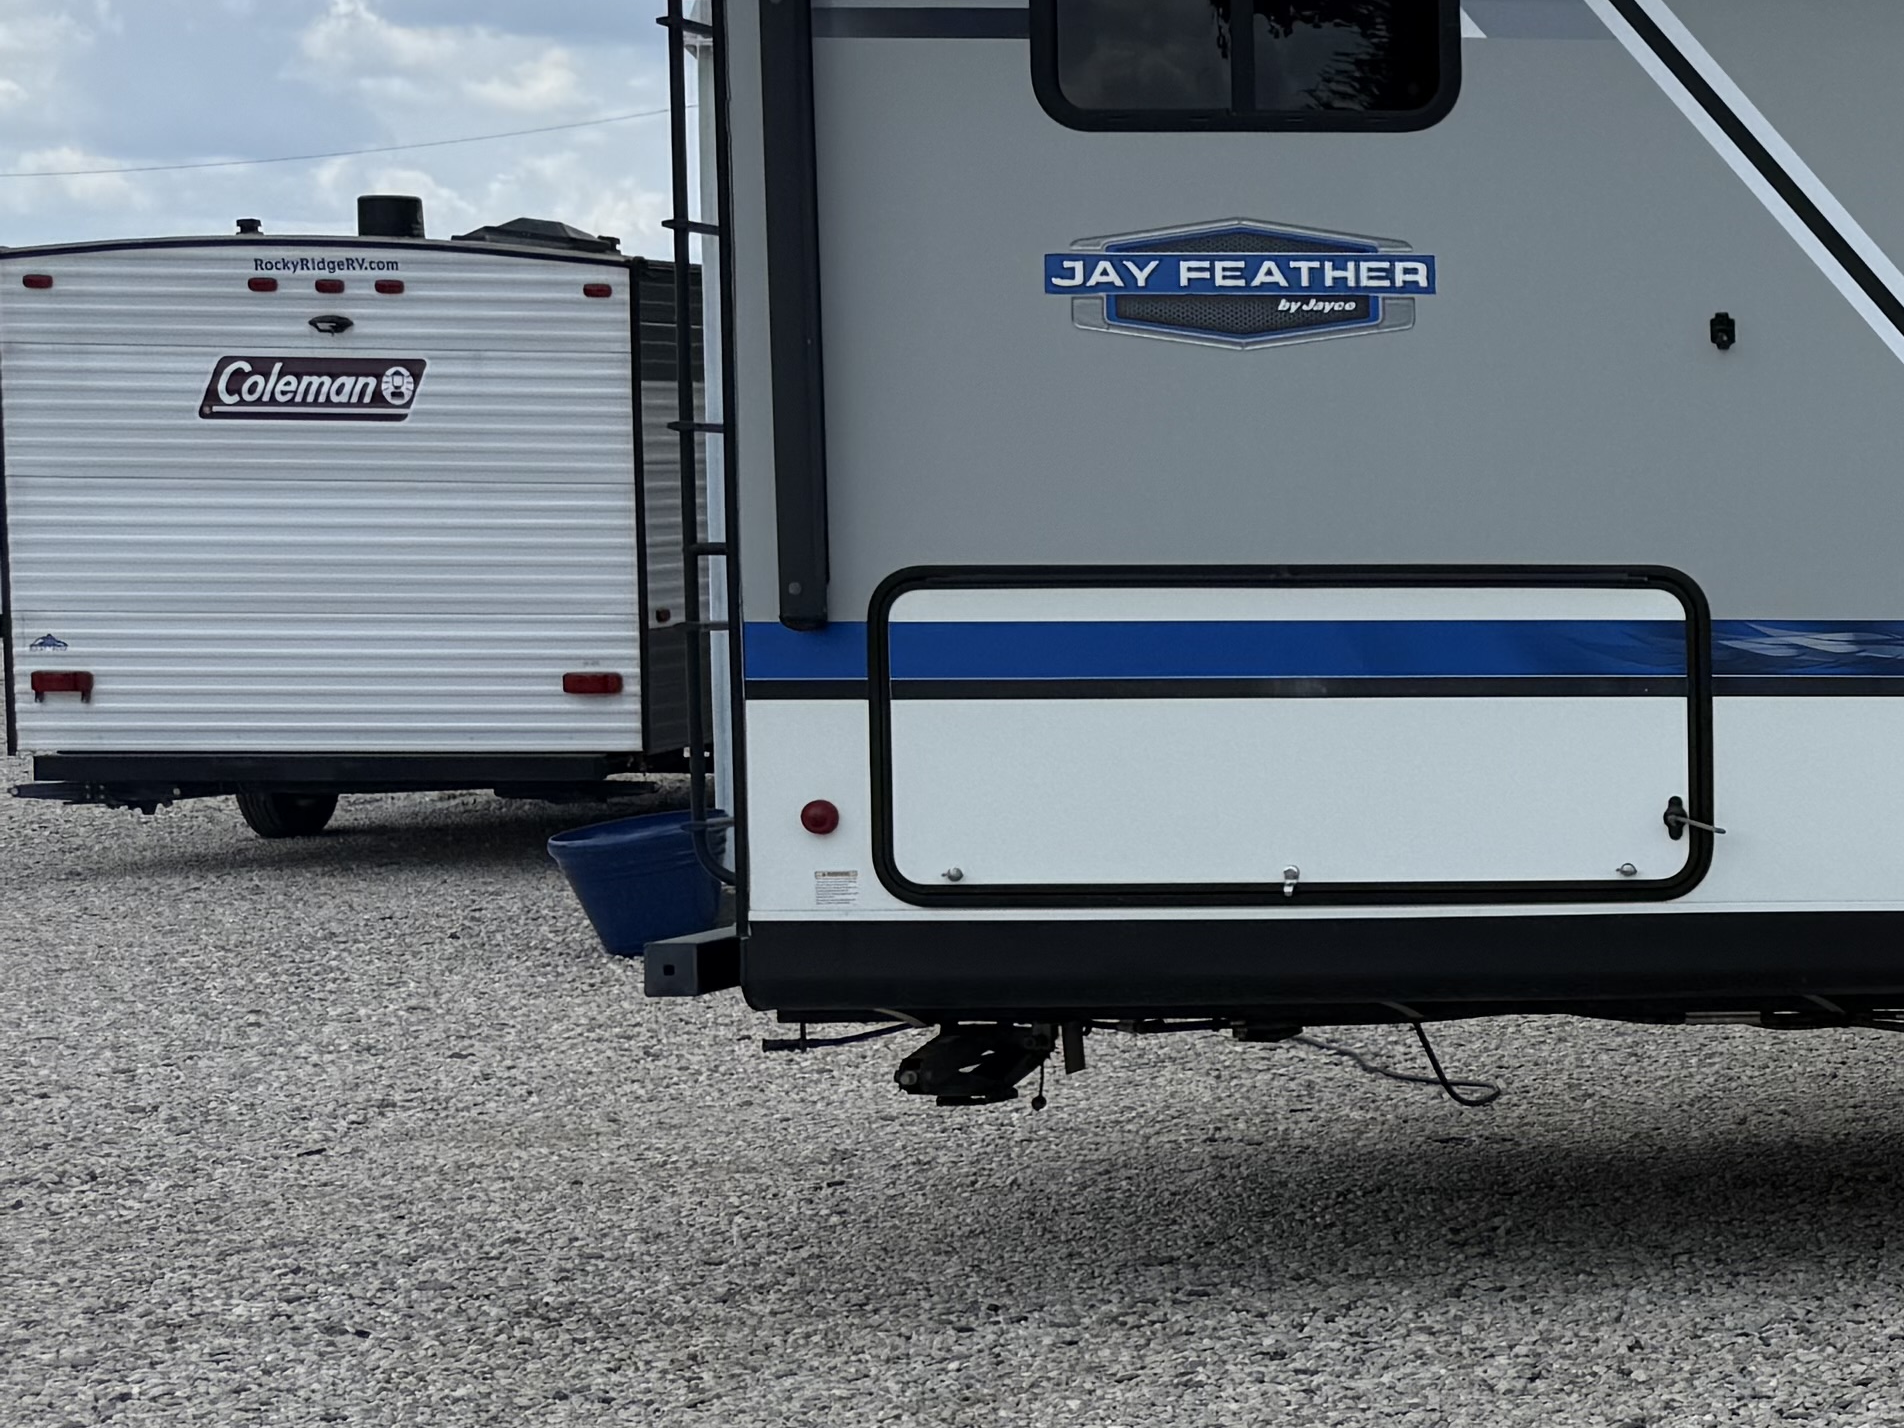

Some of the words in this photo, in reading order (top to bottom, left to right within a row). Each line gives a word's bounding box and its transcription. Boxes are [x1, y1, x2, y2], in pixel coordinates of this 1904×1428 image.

[253, 258, 400, 274] RockyRidgeRV.com
[1051, 260, 1159, 288] JAY
[1179, 260, 1429, 288] FEATHER
[1277, 298, 1302, 313] by
[1302, 298, 1357, 313] Jayco
[217, 360, 378, 405] Coleman
